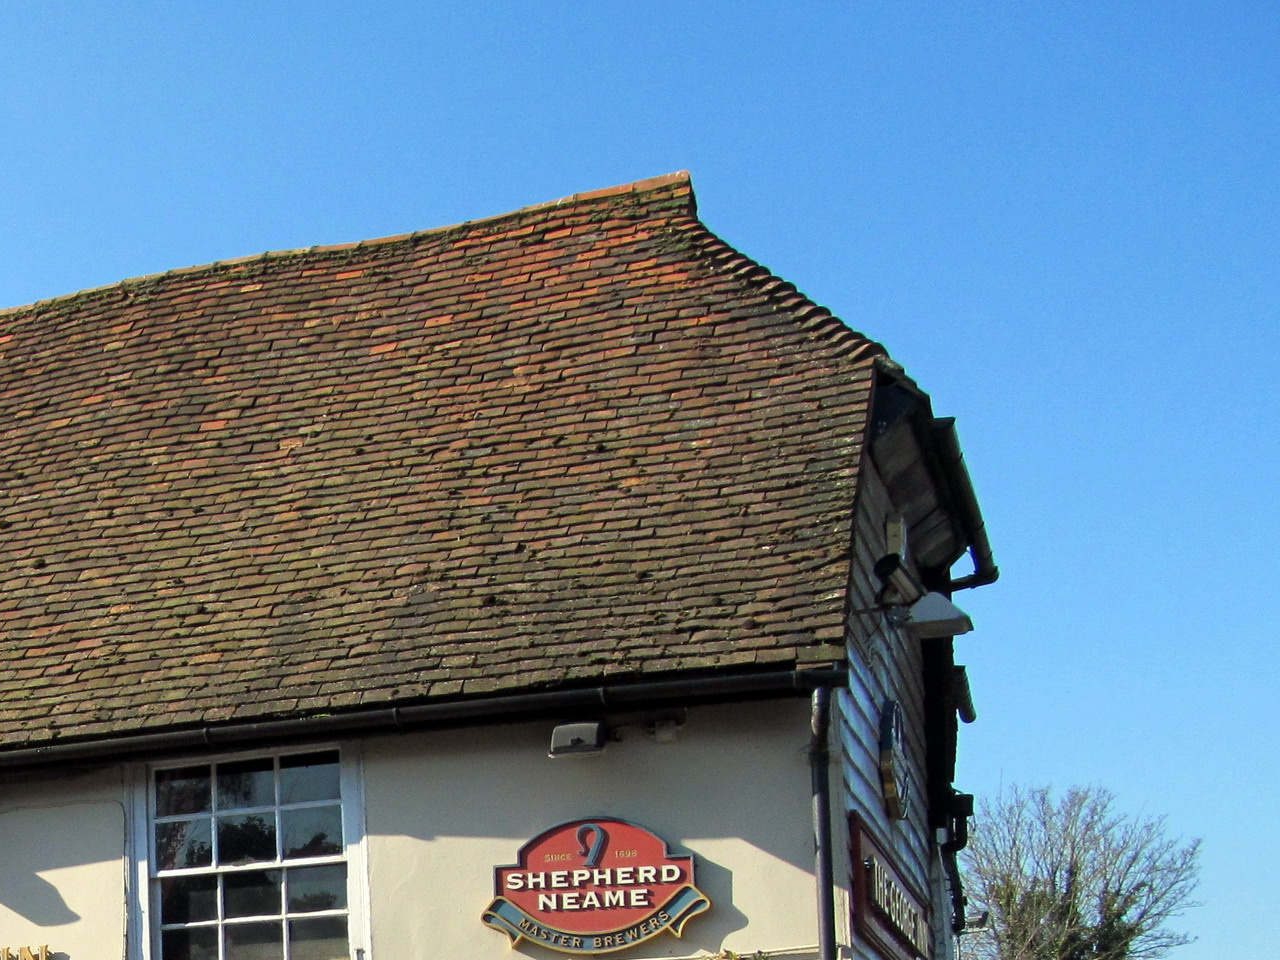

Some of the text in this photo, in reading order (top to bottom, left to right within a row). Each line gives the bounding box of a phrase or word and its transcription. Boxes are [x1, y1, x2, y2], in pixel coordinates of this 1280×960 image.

[544, 849, 638, 863] SINCE 1698
[506, 865, 682, 890] SHEPHERD
[538, 889, 649, 911] NEAME
[518, 911, 670, 948] MASTER BREWERS
